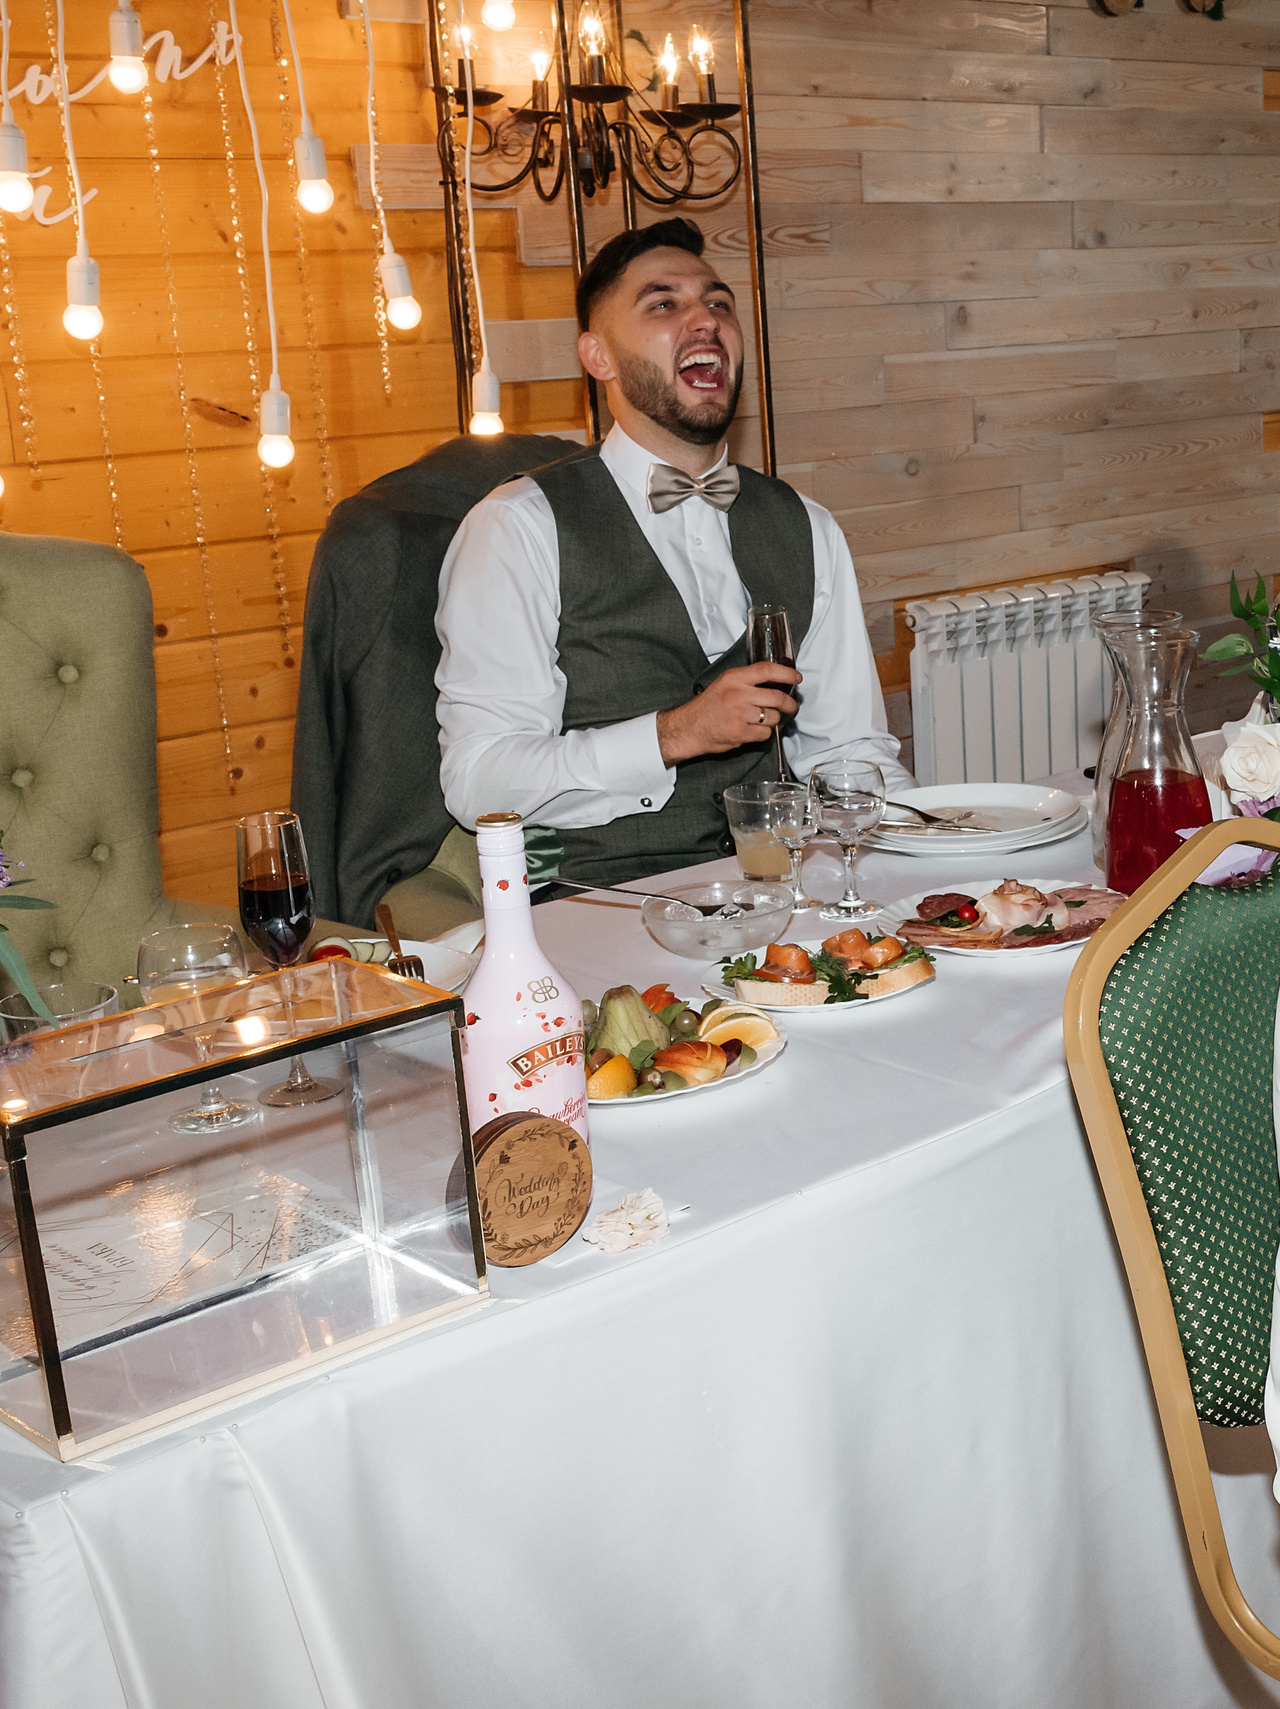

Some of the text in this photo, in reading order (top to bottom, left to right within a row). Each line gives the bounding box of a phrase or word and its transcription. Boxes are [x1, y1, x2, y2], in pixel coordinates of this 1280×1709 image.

[516, 1036, 584, 1073] BAILEYS
[495, 1162, 568, 1208] Wedding
[505, 1192, 560, 1219] Day
